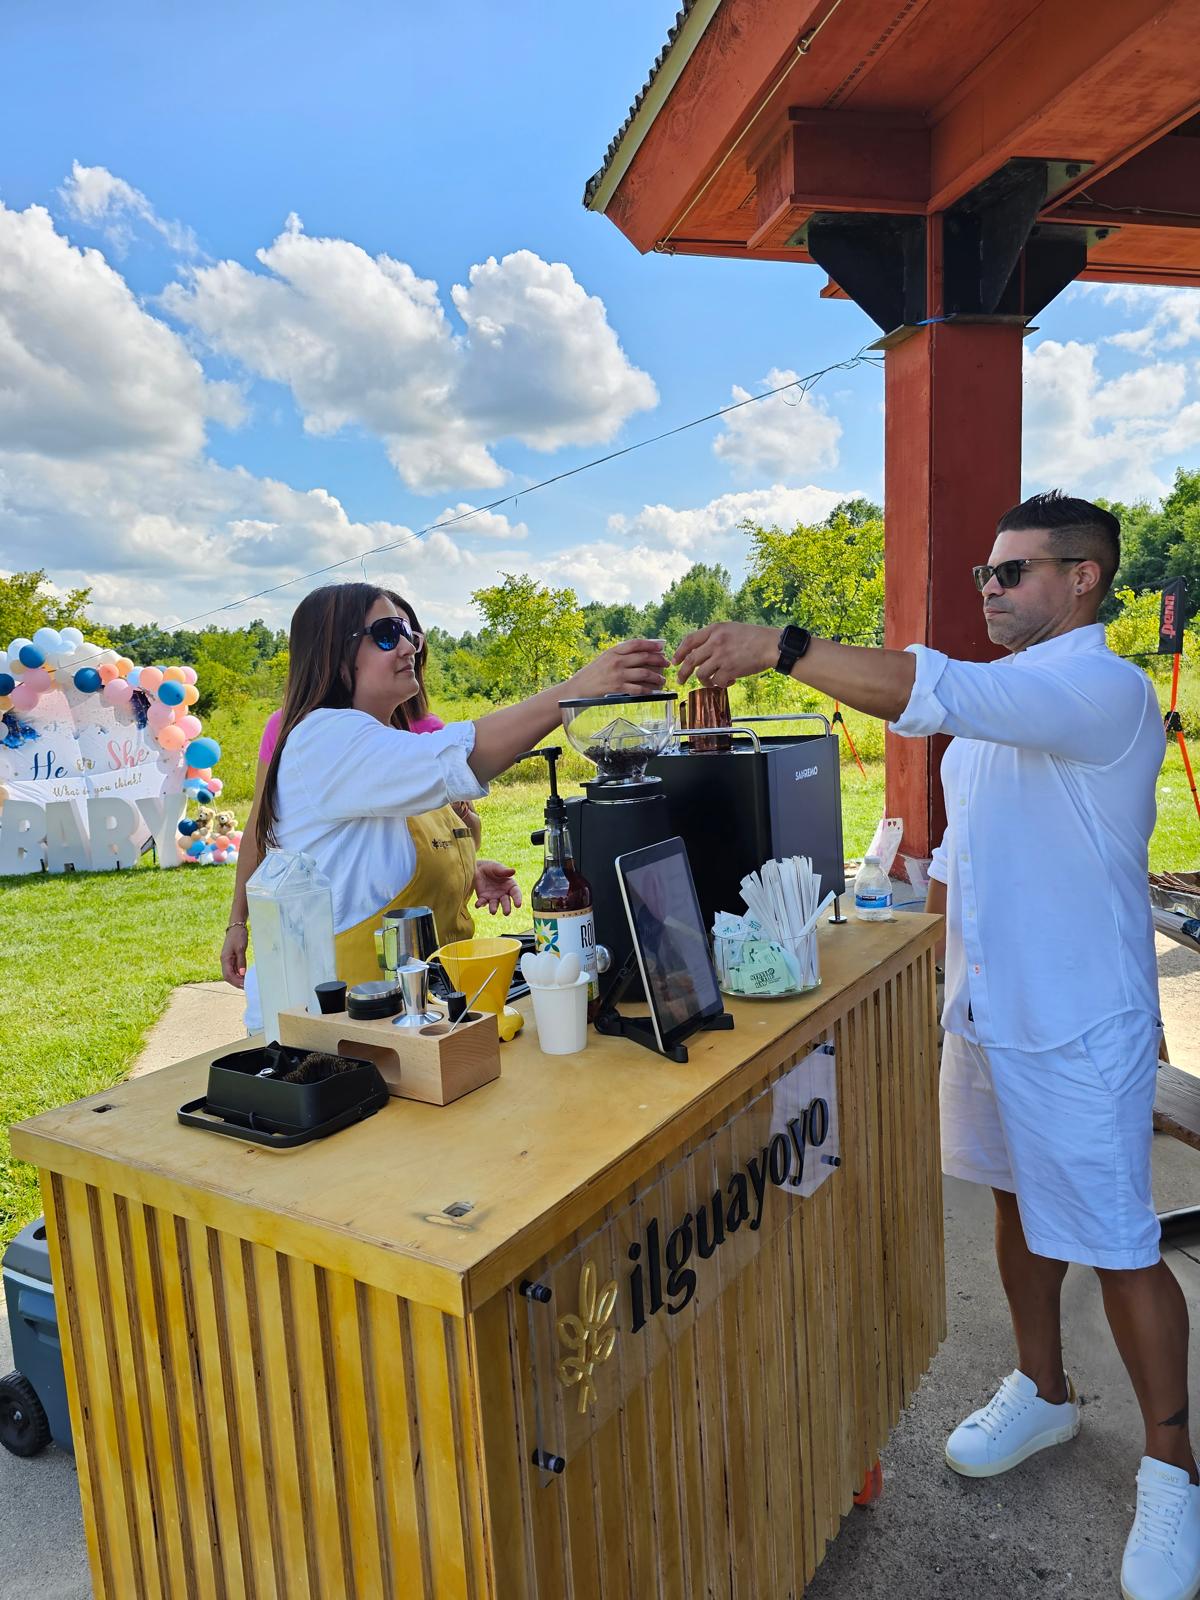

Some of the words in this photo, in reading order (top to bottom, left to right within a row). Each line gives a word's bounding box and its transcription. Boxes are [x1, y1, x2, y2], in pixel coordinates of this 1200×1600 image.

[30, 750, 68, 780] He
[107, 740, 149, 770] She
[629, 1097, 829, 1334] ilguayoyo
